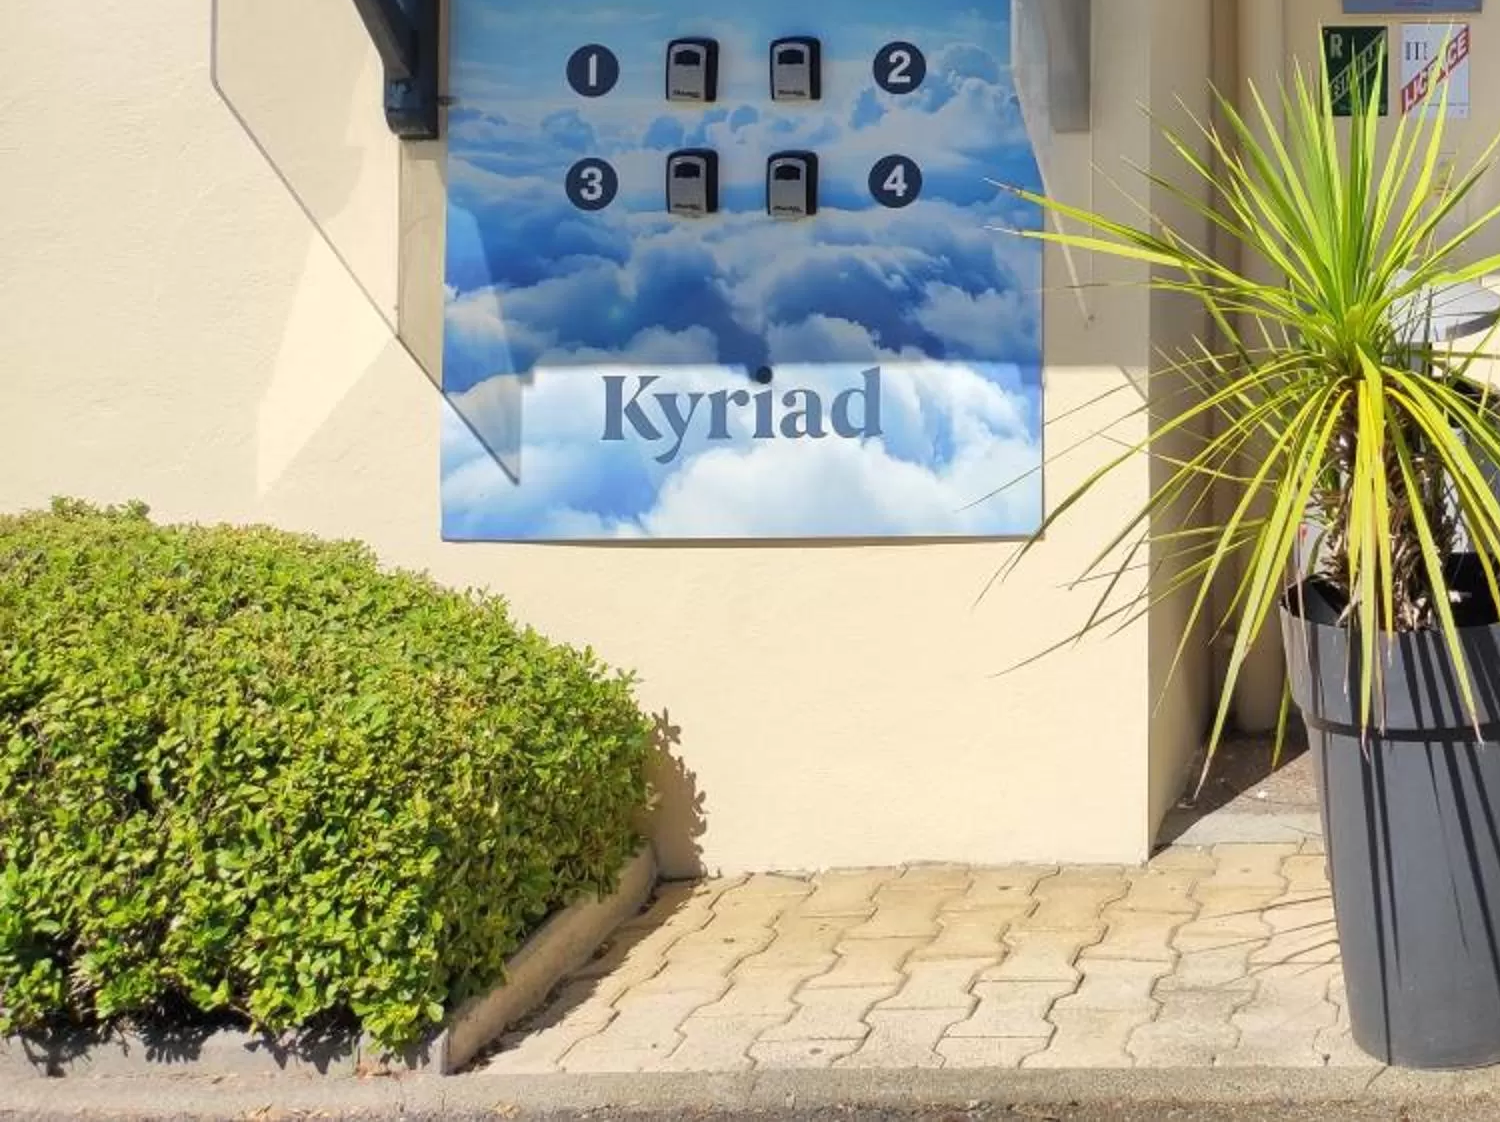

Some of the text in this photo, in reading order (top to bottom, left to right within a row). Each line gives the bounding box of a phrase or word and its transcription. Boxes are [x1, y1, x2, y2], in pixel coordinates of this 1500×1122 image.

[588, 54, 598, 87] 1
[887, 50, 912, 84] 2
[580, 165, 603, 200] 3
[882, 163, 908, 197] 4
[601, 366, 884, 465] Kyriad
